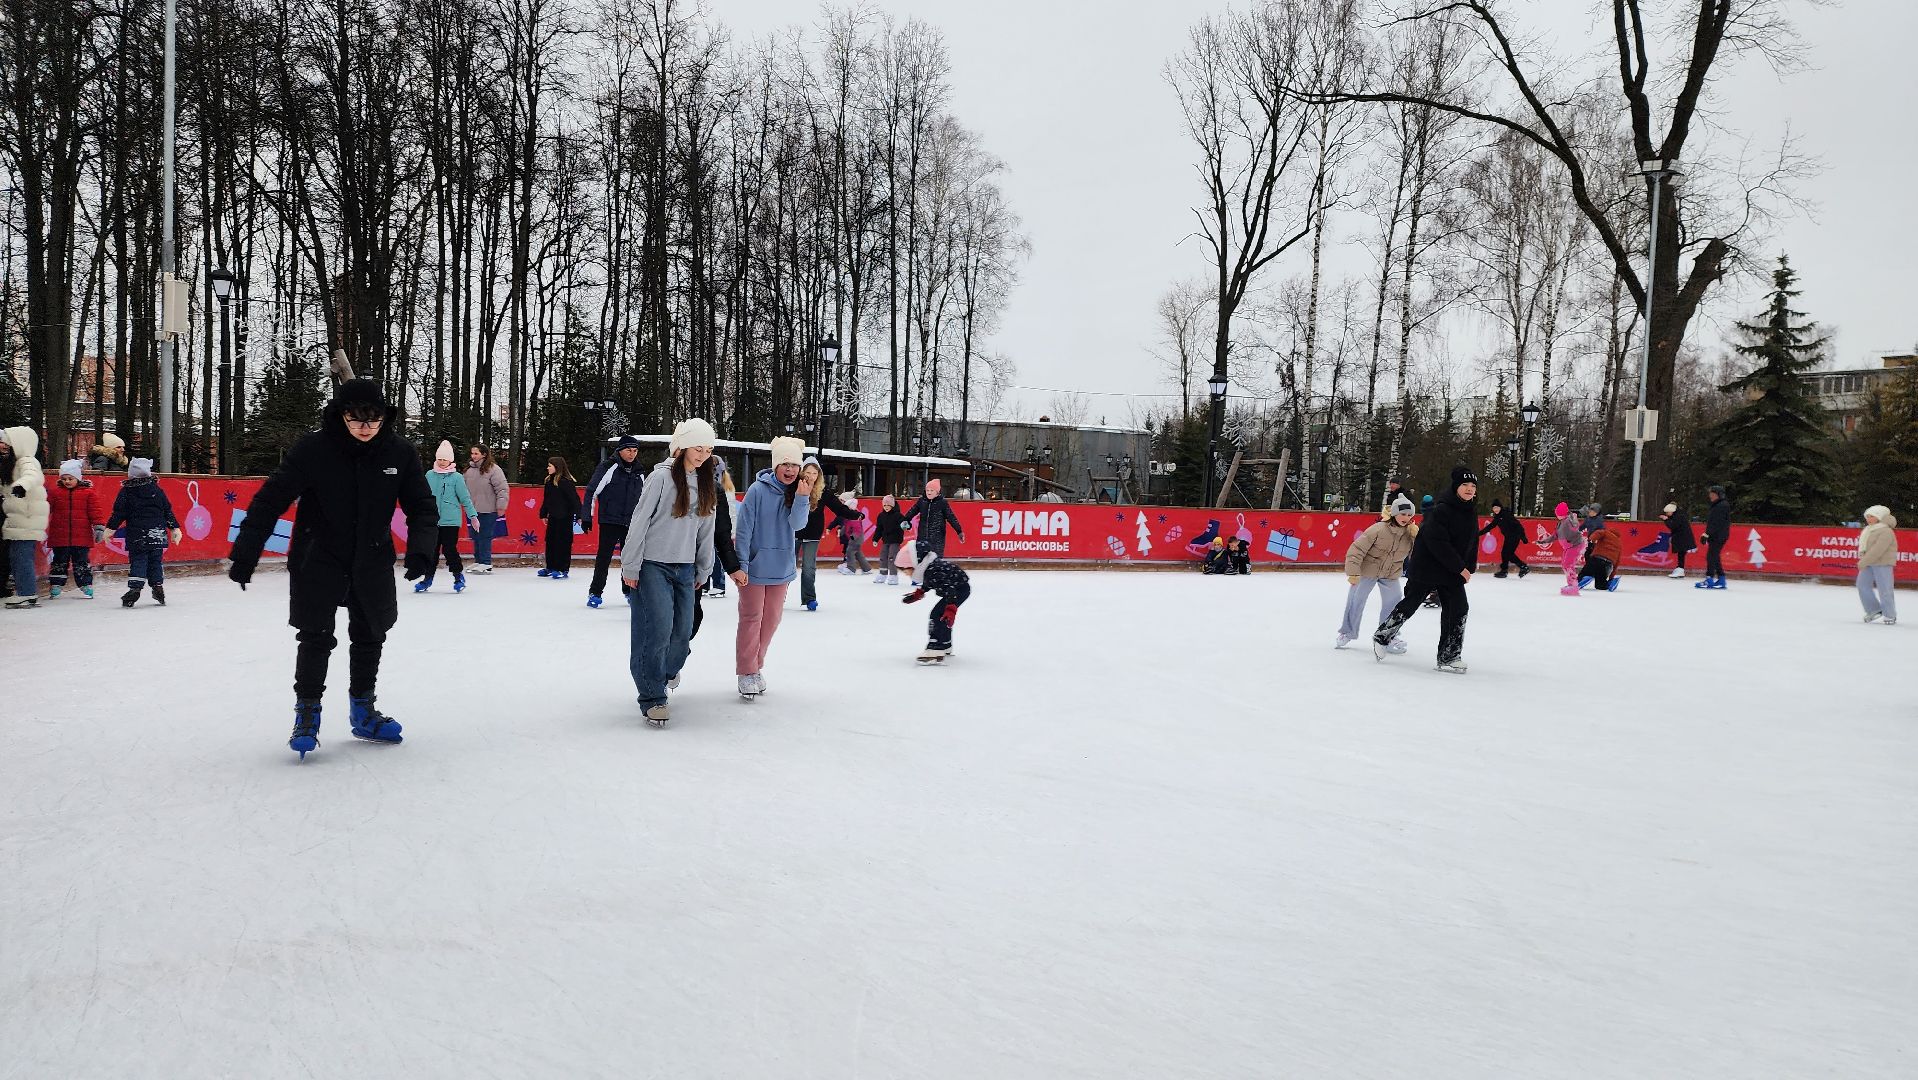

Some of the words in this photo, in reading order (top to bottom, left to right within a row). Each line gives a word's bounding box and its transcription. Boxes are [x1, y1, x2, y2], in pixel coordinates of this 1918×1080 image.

[982, 509, 1069, 536] ЗИМА
[982, 541, 989, 550] В
[991, 541, 1069, 551] ПОДМОСКОВЬЕ
[1794, 548, 1803, 556] С
